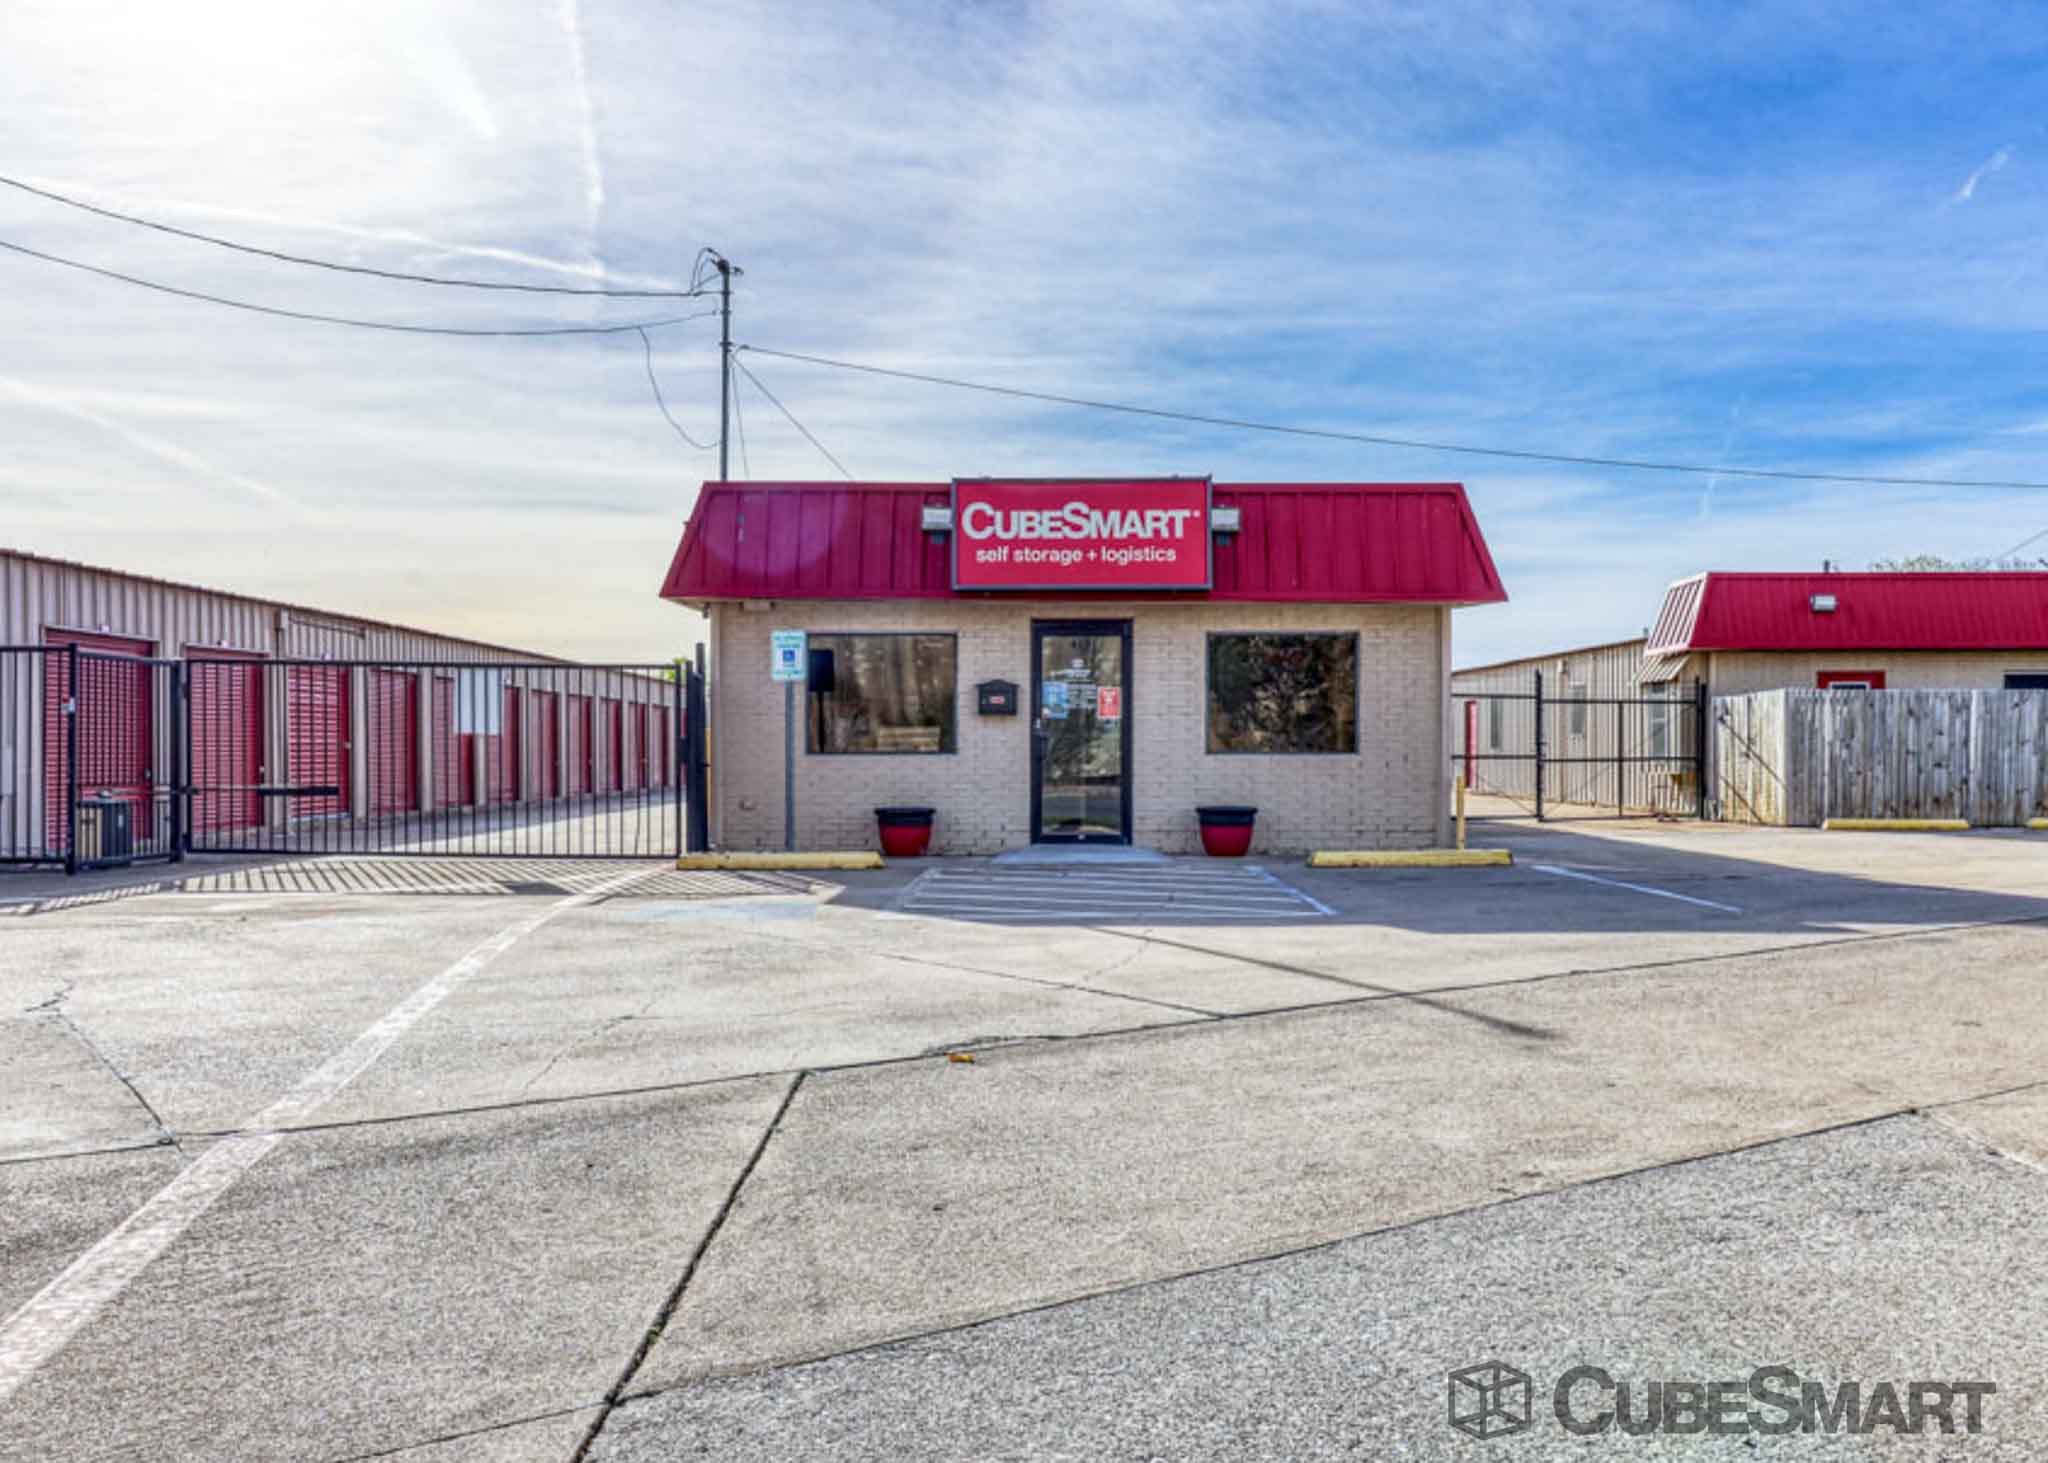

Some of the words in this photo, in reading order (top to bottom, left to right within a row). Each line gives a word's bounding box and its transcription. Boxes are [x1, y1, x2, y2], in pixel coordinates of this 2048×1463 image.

[976, 546, 1008, 562] self
[1013, 547, 1083, 566] storage
[1087, 550, 1098, 561] +
[1101, 546, 1176, 566] logistics
